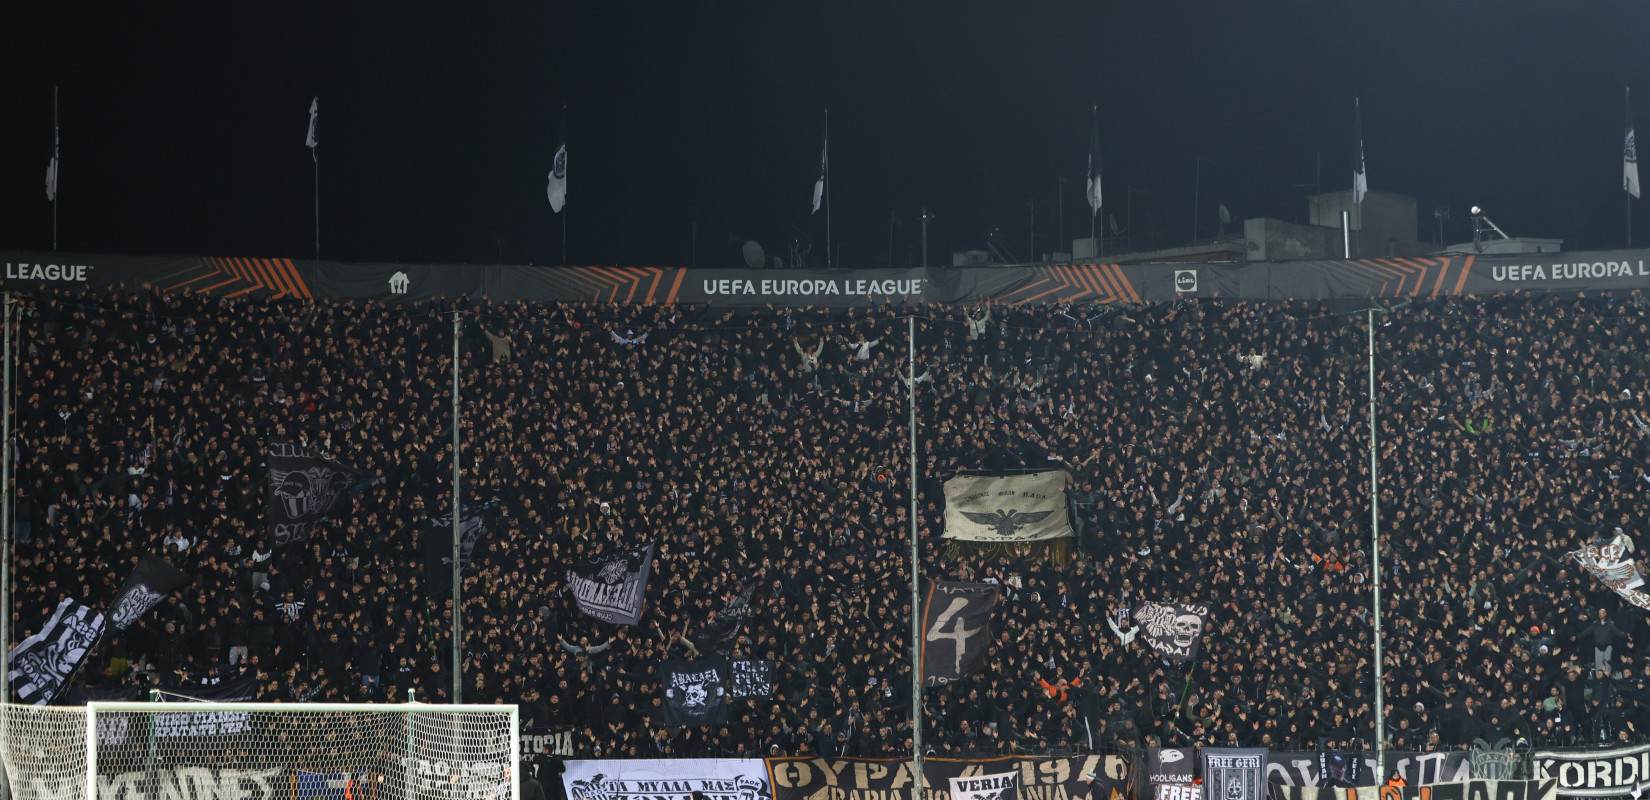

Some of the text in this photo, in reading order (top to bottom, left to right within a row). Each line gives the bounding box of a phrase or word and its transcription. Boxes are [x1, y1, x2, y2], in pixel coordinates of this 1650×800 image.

[1492, 264, 1547, 282] UEFA
[1552, 261, 1633, 280] EUROPA
[703, 279, 756, 295] UEFA
[761, 279, 839, 295] EUROPA
[926, 597, 985, 675] 4
[520, 730, 574, 757] TORIA
[1208, 758, 1260, 769] FREE GERI
[957, 776, 1013, 792] VERIA
[1150, 774, 1193, 783] HOOLIGANS
